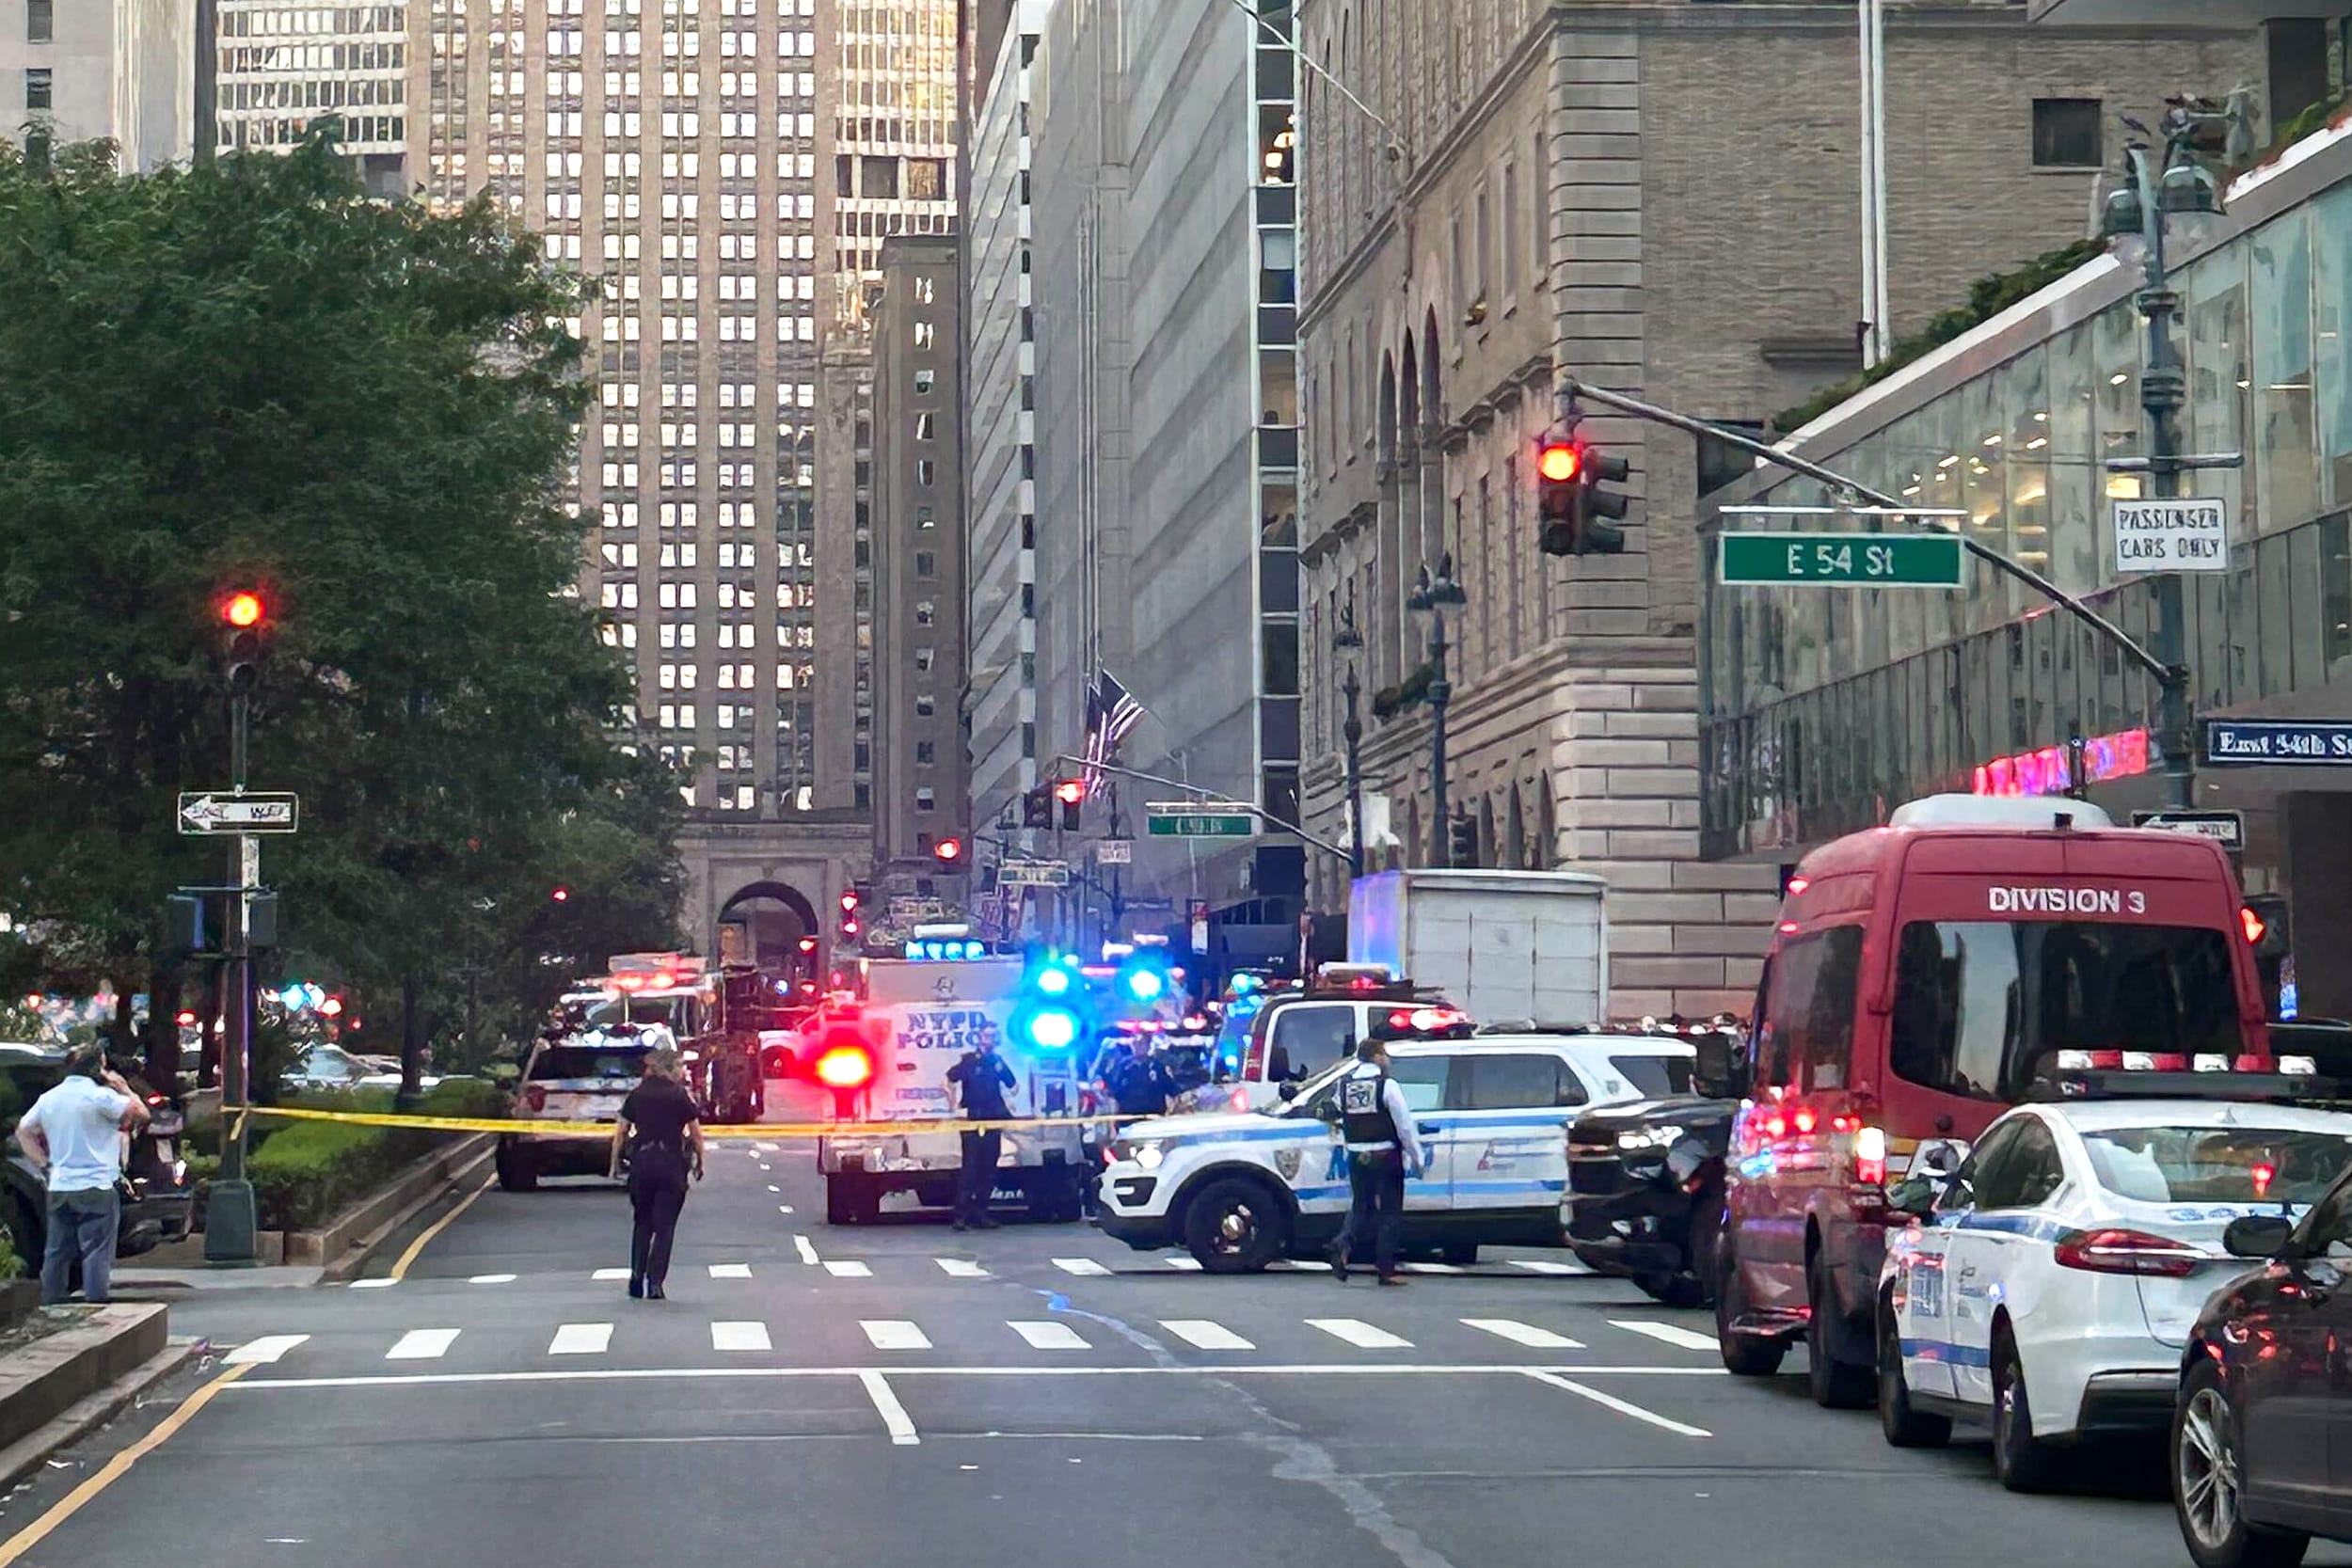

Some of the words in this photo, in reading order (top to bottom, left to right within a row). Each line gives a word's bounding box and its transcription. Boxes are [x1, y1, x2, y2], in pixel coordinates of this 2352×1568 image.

[2120, 537, 2166, 558] CARS
[2177, 537, 2219, 558] ONLY
[1788, 544, 1804, 574] E
[1817, 544, 1851, 575] 54
[1866, 546, 1894, 576] St
[1988, 887, 2120, 912] DIVISION
[2127, 891, 2145, 913] 3
[907, 1011, 986, 1032] NYPD
